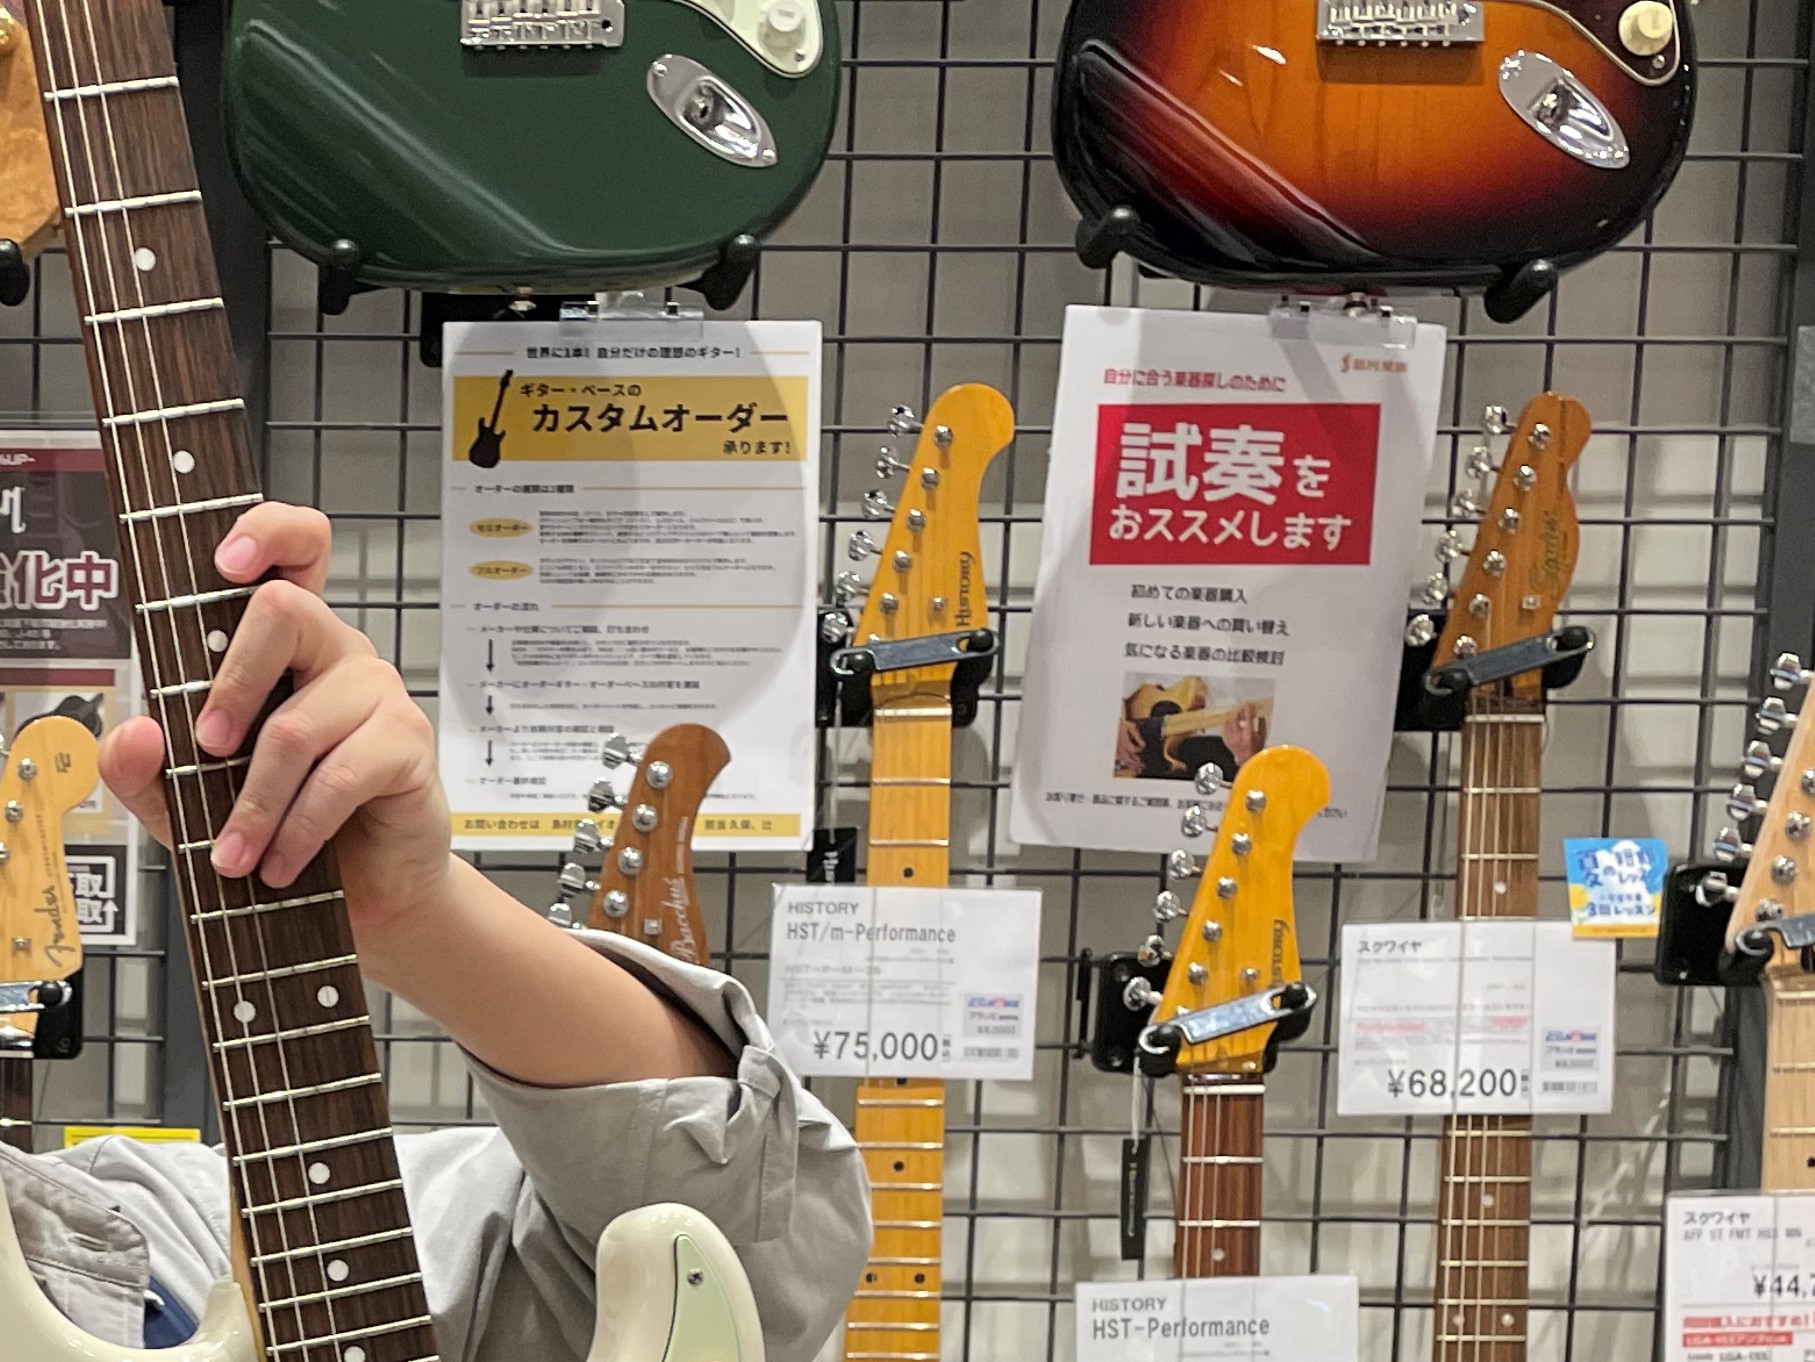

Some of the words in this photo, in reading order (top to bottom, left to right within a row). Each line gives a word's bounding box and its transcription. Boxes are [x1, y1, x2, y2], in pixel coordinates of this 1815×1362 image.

[519, 383, 643, 398] ギター・ベースの
[1103, 367, 1287, 393] 自分に合う楽器探しのために
[532, 402, 789, 433] カスタムオーダー
[722, 439, 792, 455] 承ります!
[1115, 421, 1332, 506] 試奏を
[1108, 504, 1353, 552] おススメします
[1130, 583, 1248, 605] 初めての楽器購入
[1127, 612, 1291, 637] 新しい楽器への買い替え
[1123, 641, 1286, 666] 気になる楽器の比較検討
[464, 819, 540, 830] お問い合わせは
[787, 900, 860, 916] HISTORY
[34, 884, 77, 968] Fender
[786, 921, 957, 944] HST/m-Performance
[1357, 940, 1423, 954] スクワイヤ
[813, 1031, 940, 1062] ¥75,000
[1387, 1067, 1518, 1098] ¥68,200
[1683, 1211, 1751, 1226] スクワイヤ
[1091, 1297, 1169, 1312] HISTORY
[1091, 1317, 1271, 1341] HST-Performance
